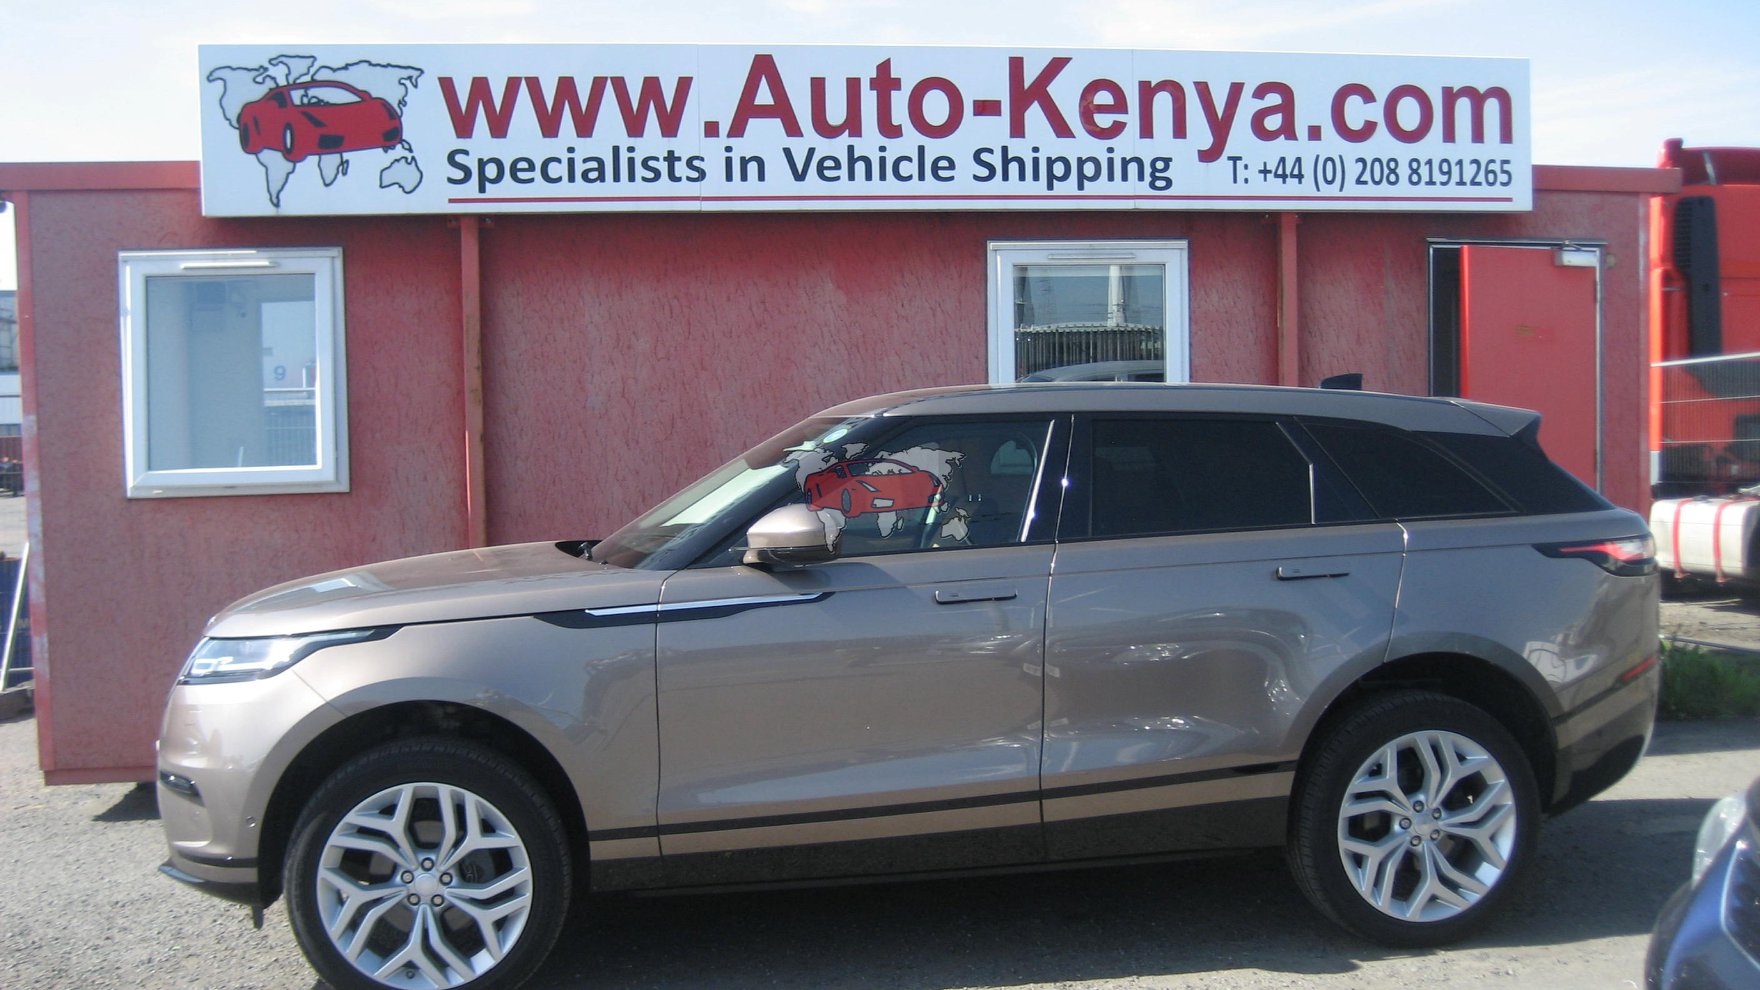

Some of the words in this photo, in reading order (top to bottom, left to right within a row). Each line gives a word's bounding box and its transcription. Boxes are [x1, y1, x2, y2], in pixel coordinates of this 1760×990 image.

[438, 54, 1512, 164] www.Auto-Kenya.com
[446, 145, 707, 195] Specialists
[723, 145, 766, 184] in
[781, 144, 957, 183] Vehicle
[972, 145, 1173, 192] Shipping
[1226, 155, 1250, 185] T:
[1257, 156, 1305, 185] +44
[1312, 154, 1346, 193] (0)
[1354, 156, 1400, 187] 208
[1407, 157, 1513, 188] 8191265
